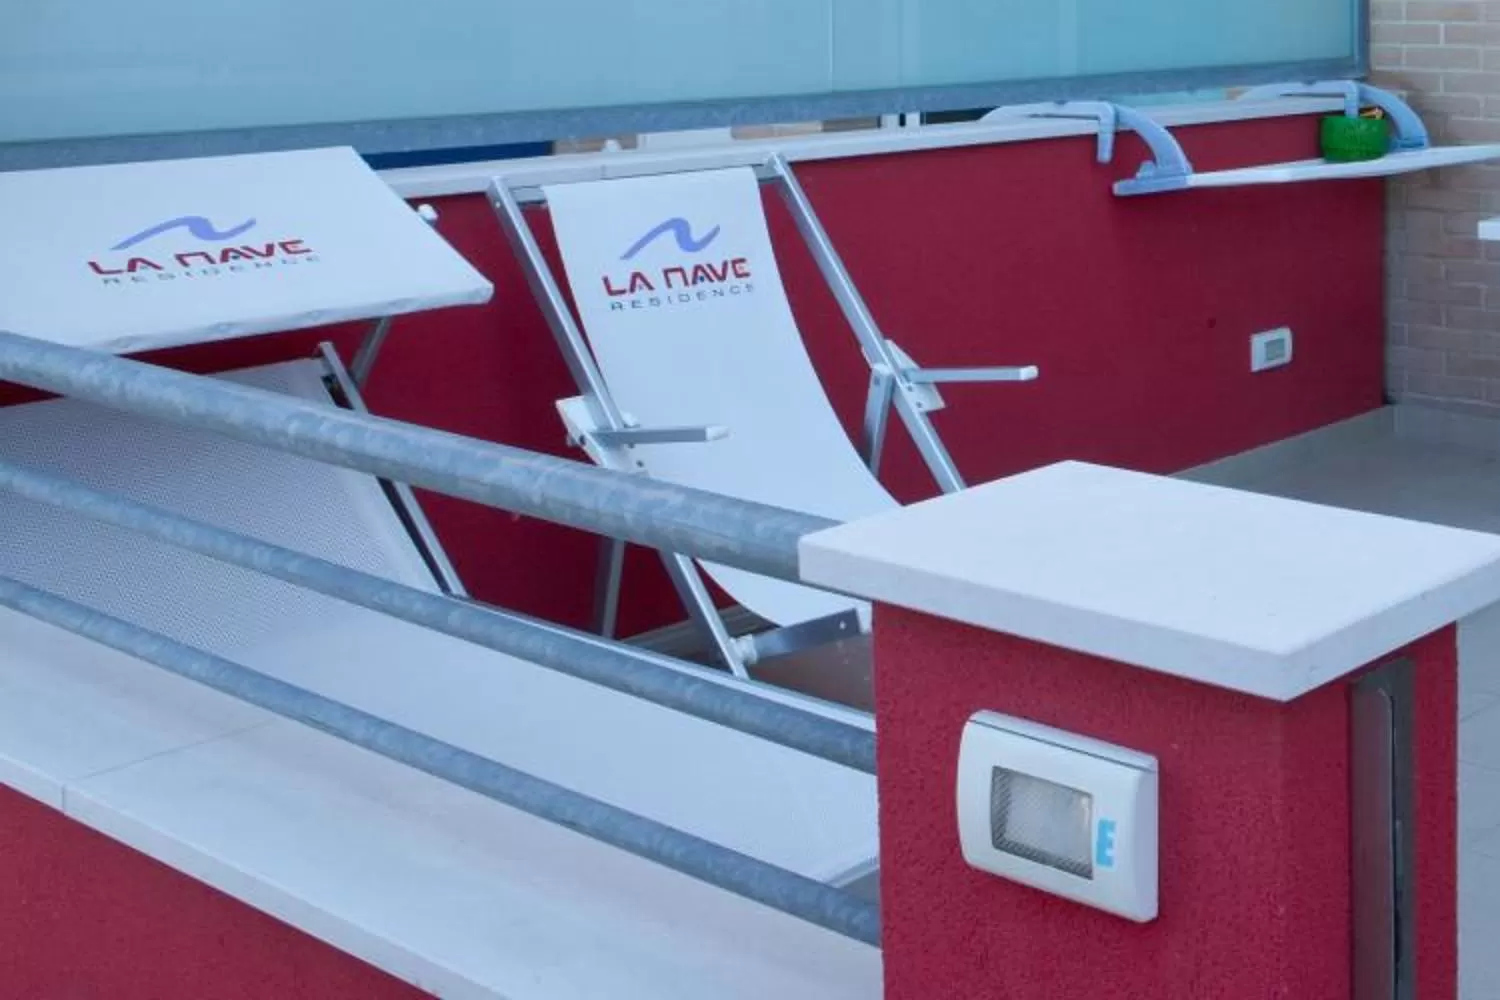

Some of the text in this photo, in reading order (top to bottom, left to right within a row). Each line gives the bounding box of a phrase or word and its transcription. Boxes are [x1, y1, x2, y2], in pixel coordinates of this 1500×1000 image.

[87, 239, 313, 275] LA NAVE
[601, 256, 752, 297] LA NAVE
[609, 282, 755, 312] RESIDENCE
[1095, 817, 1118, 869] E
